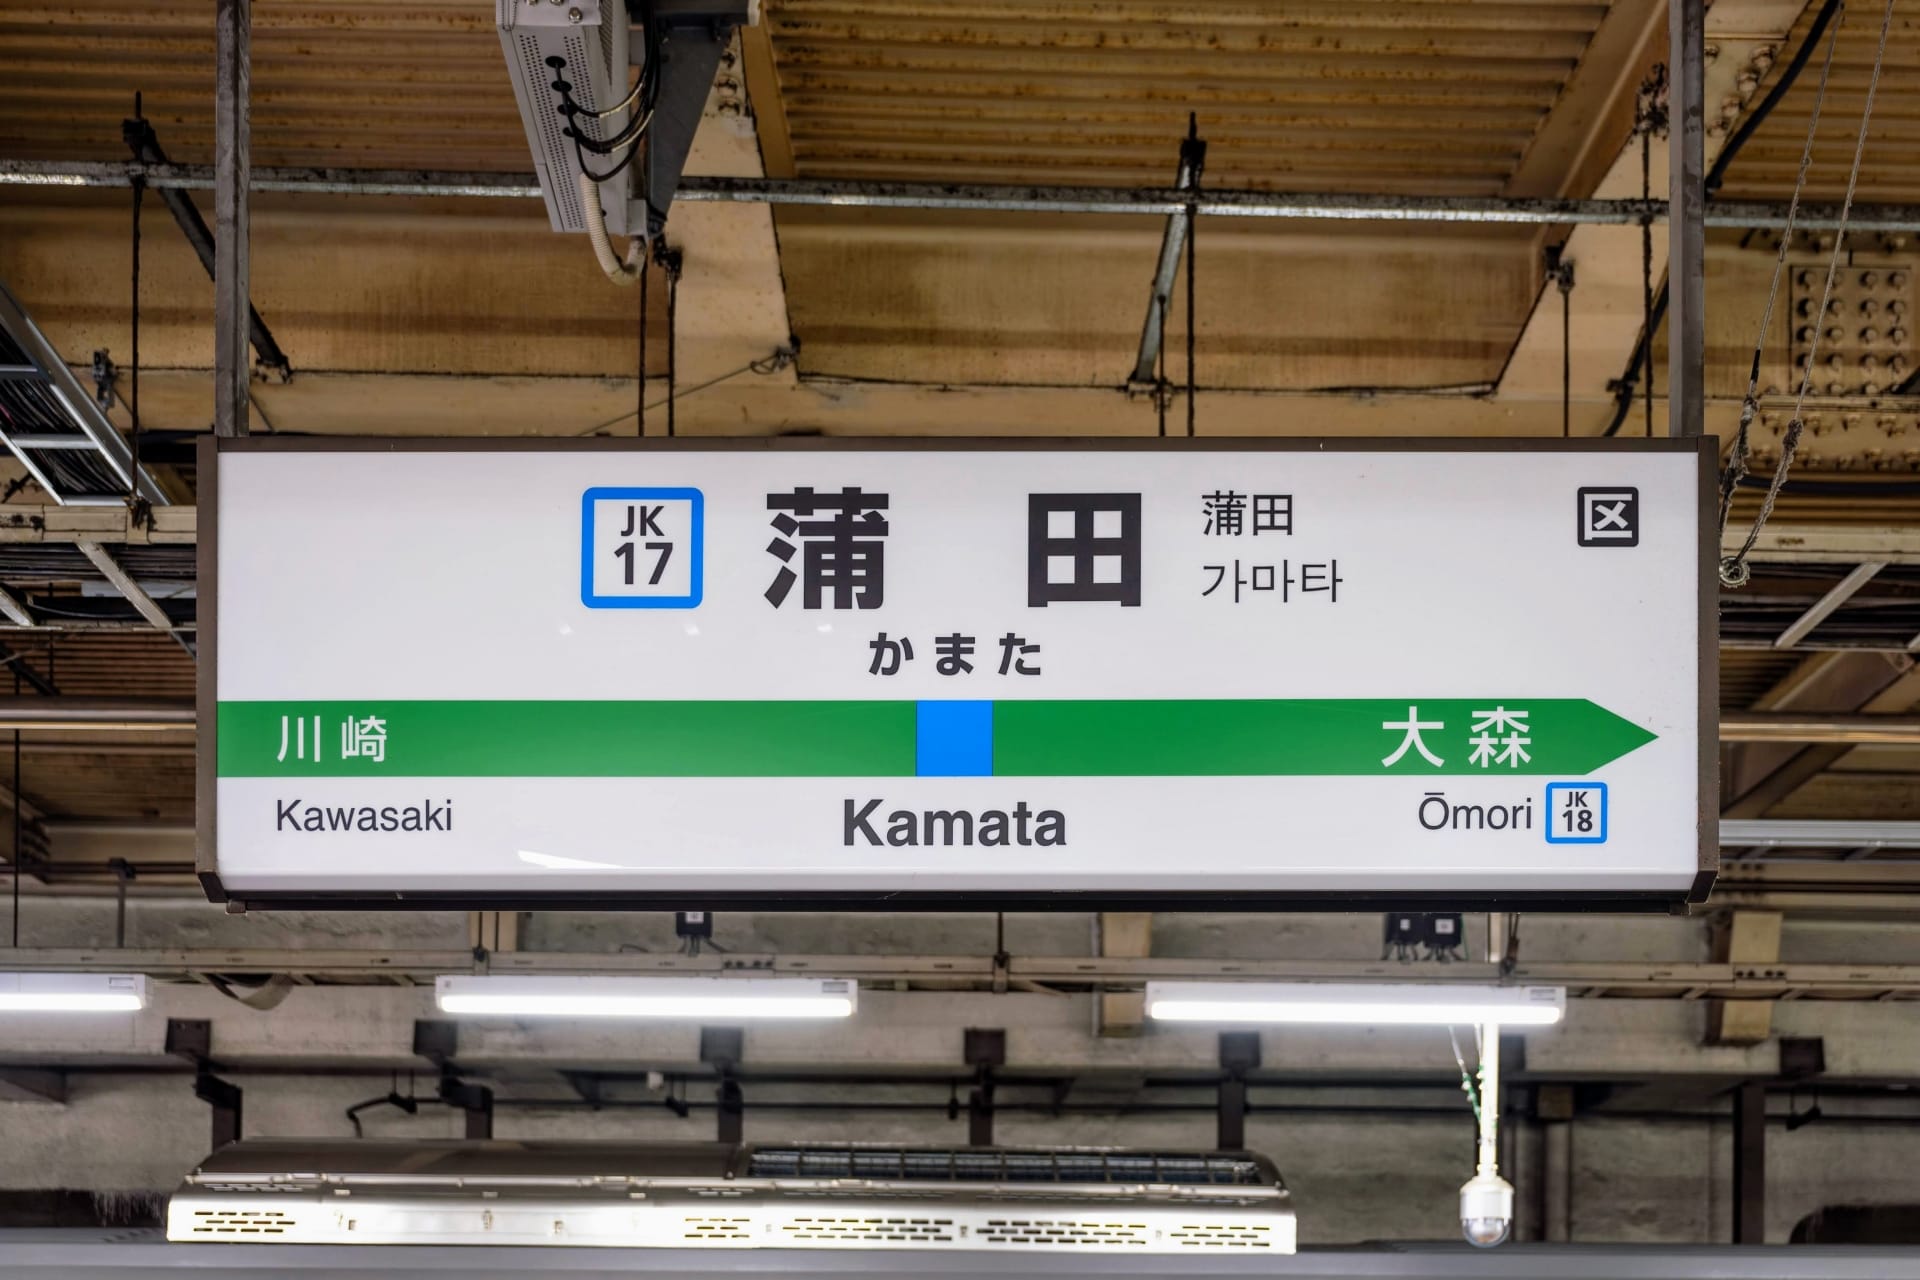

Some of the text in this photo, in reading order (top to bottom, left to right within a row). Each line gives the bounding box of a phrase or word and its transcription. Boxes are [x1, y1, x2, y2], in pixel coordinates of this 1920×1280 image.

[620, 505, 665, 537] JK
[1201, 489, 1294, 537] 蒲田
[1583, 492, 1634, 540] 区
[613, 542, 674, 585] 17
[764, 486, 1142, 609] 蒲田
[1201, 559, 1344, 604] 가마타
[868, 631, 1042, 677] かまた
[276, 714, 388, 763] 川崎
[1381, 706, 1532, 768] 大森
[276, 799, 453, 832] Kawasaki
[1418, 792, 1533, 831] Ōmori
[1561, 809, 1593, 833] 18
[1565, 791, 1588, 808] JK
[843, 798, 1067, 847] Kamata
